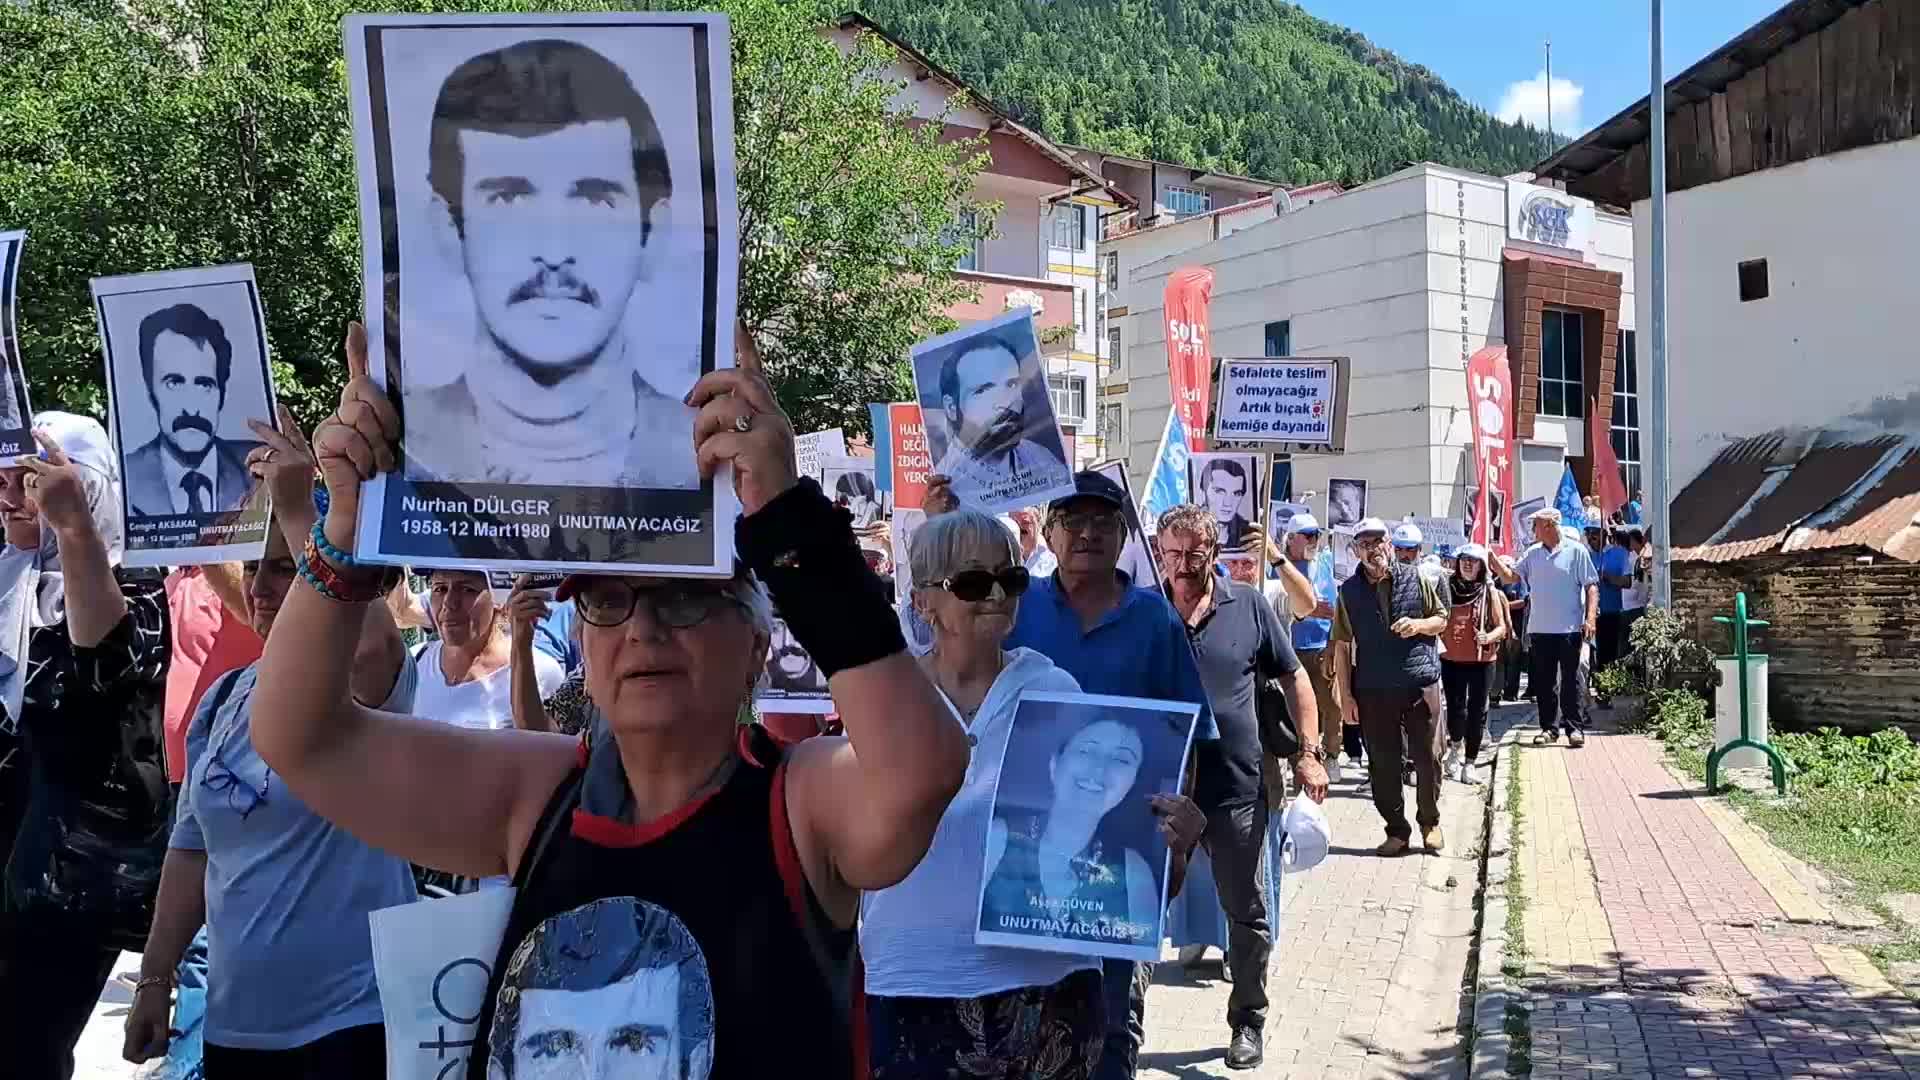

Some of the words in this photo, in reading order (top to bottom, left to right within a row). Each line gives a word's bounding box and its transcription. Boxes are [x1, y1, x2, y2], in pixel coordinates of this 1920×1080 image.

[1230, 367, 1283, 379] Sefalete
[1286, 367, 1327, 379] teslim
[1235, 383, 1319, 399] olmayacağız
[1239, 402, 1272, 413] Artık
[1274, 401, 1311, 416] bıçak
[1221, 419, 1269, 433] kemiğe
[1271, 420, 1326, 434] dayandı
[402, 495, 468, 513] Nurhan
[473, 494, 550, 516] DÜLGER
[400, 519, 469, 536] 1958-12
[473, 522, 551, 539] Mart1980
[558, 514, 701, 534] UNUTMAYACAĞIZ
